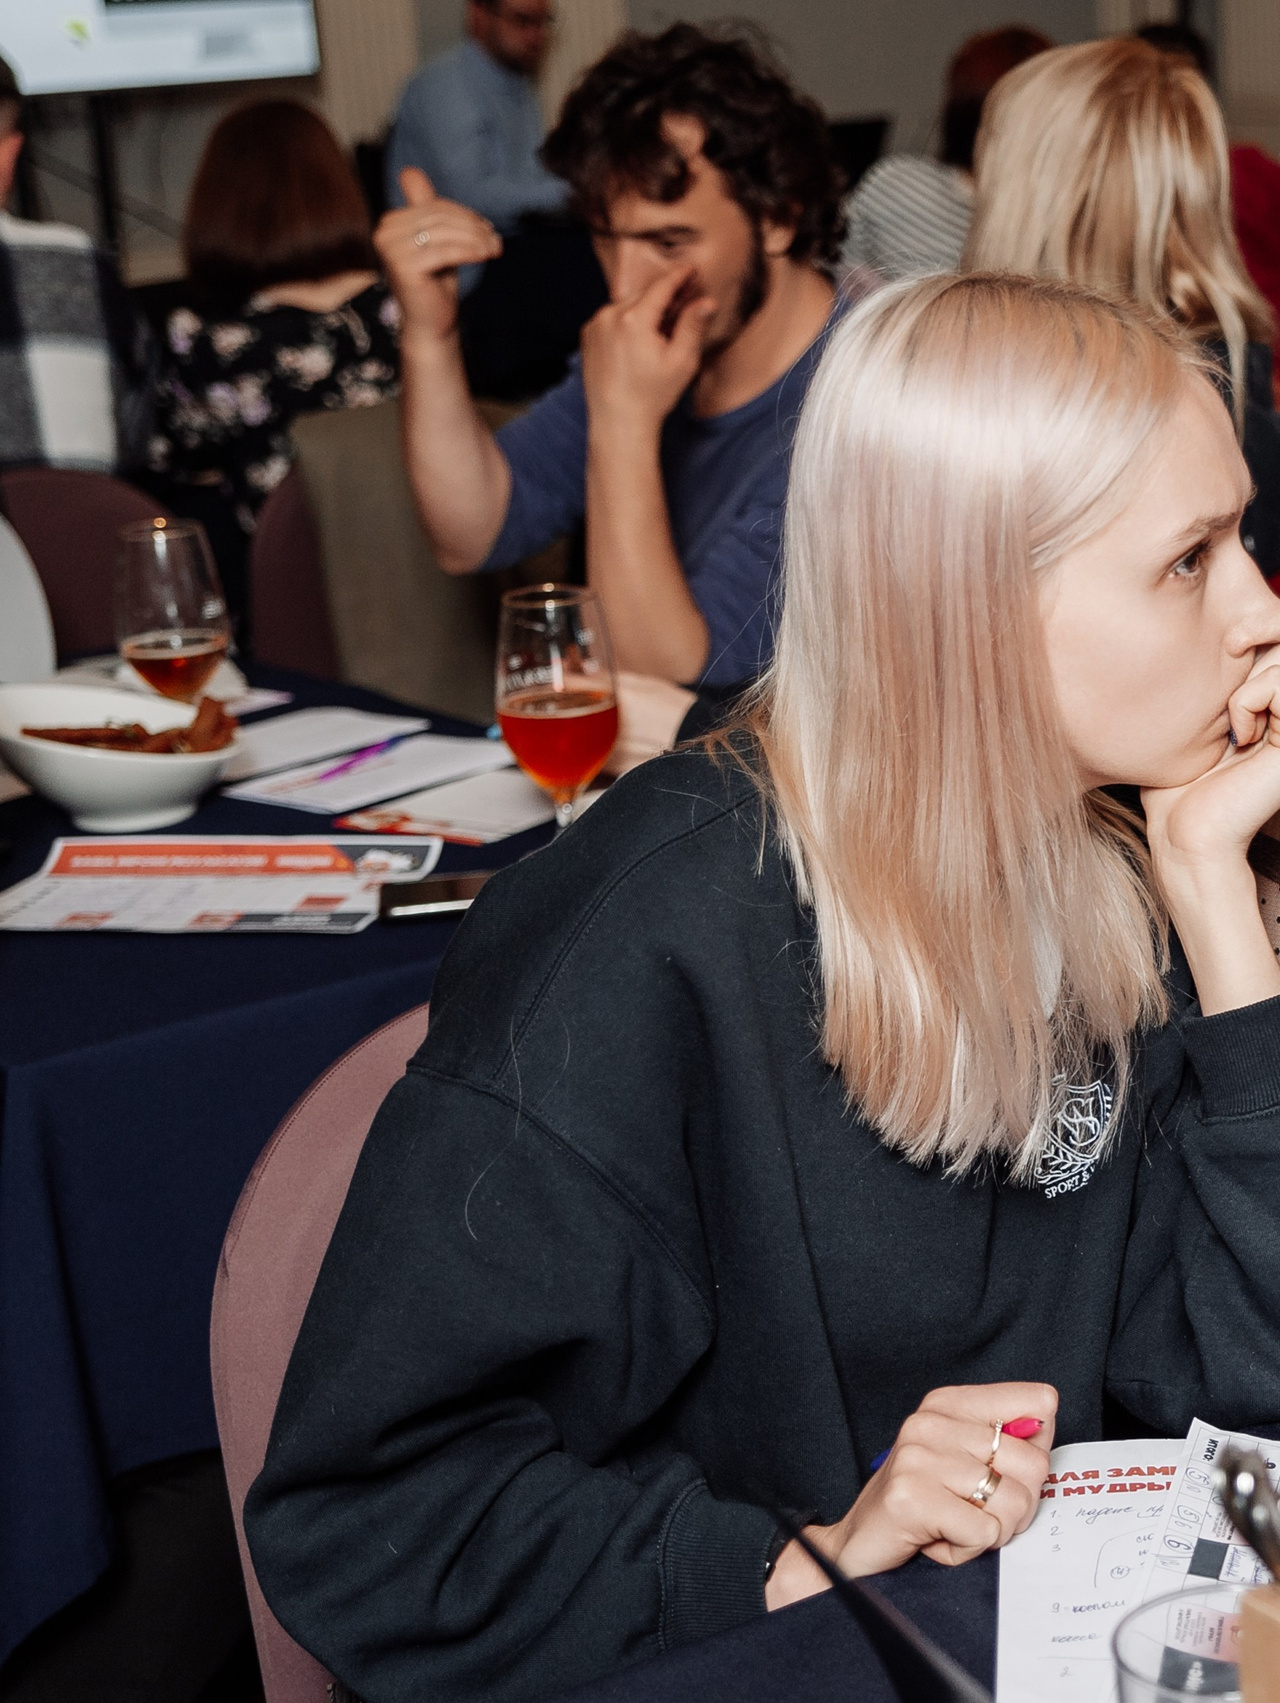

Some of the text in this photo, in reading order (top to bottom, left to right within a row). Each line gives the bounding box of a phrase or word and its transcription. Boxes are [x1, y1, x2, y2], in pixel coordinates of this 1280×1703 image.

[1044, 1175, 1080, 1199] SPORT
[1203, 1438, 1219, 1462] ИТОГО:
[1040, 1488, 1056, 1500] И
[1063, 1481, 1172, 1497] МУДРЫ
[1050, 1526, 1064, 1536] 2
